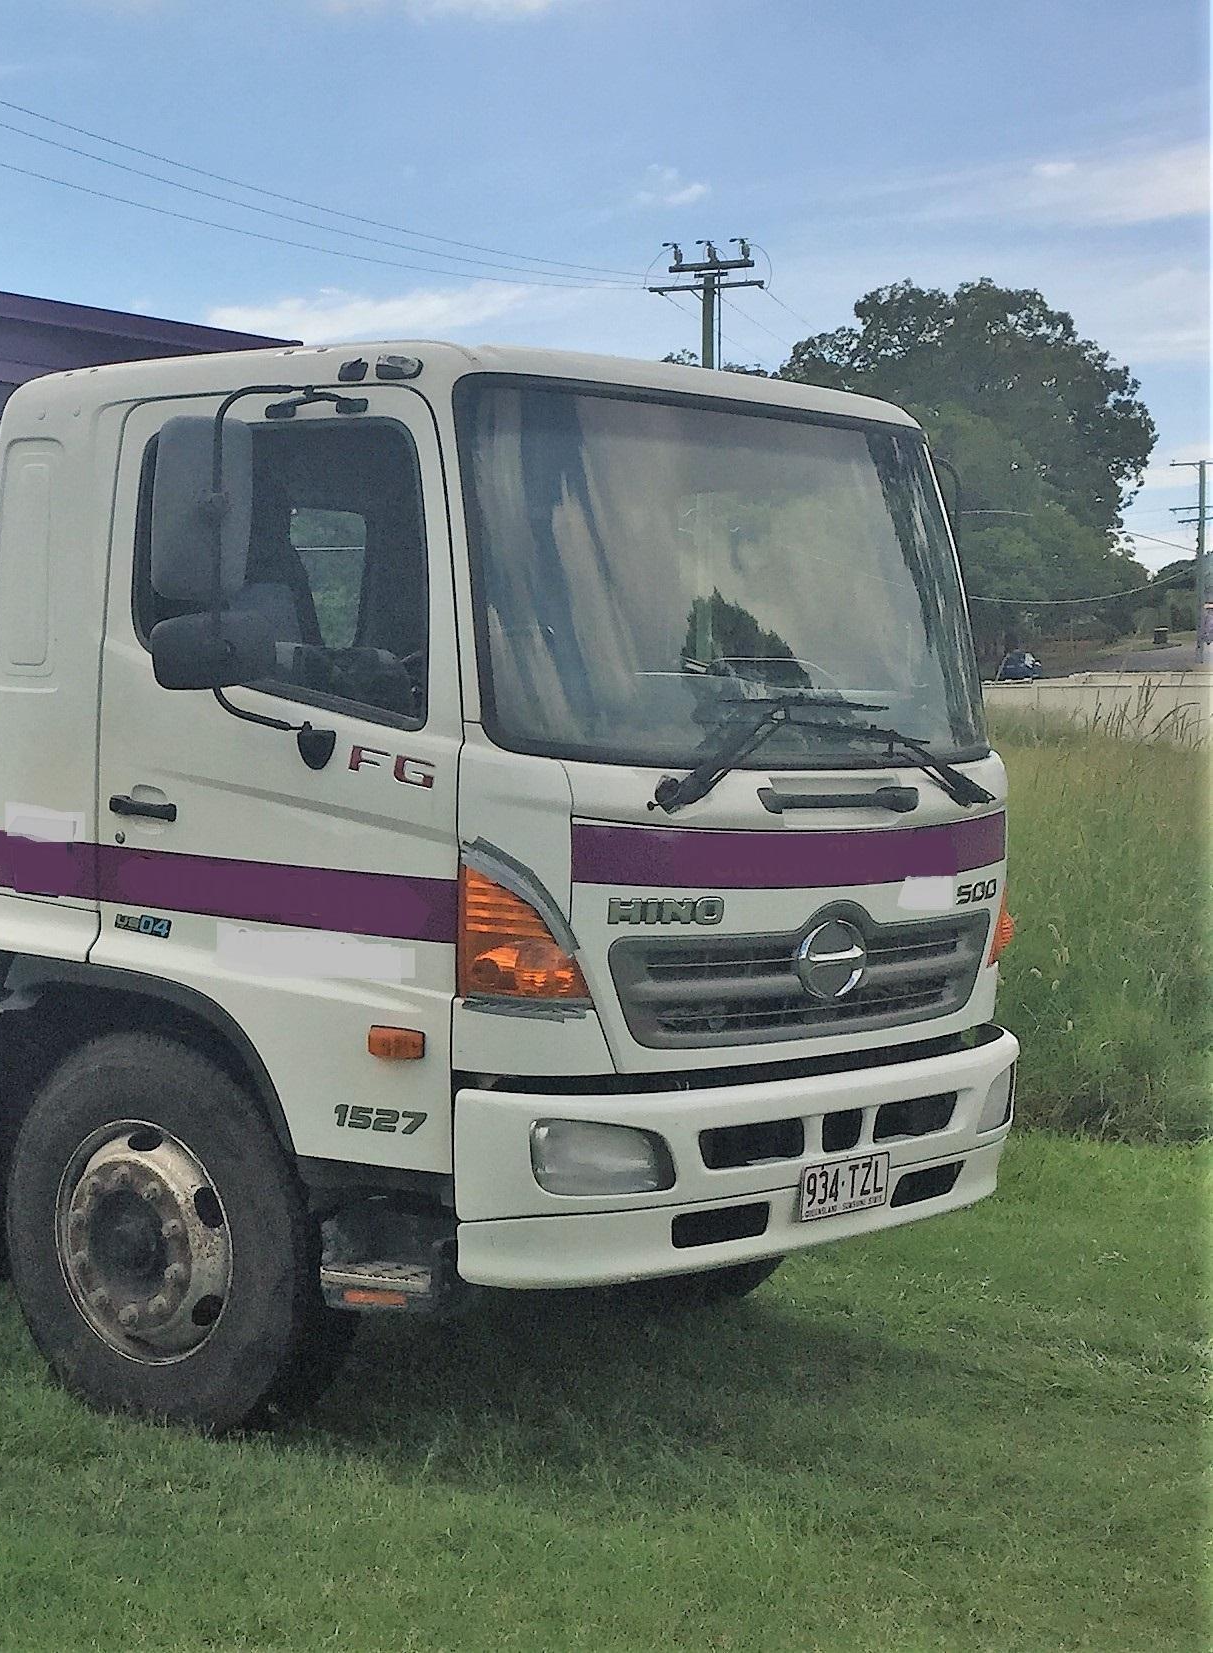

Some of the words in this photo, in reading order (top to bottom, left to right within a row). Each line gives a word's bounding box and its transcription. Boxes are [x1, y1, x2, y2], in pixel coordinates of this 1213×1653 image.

[348, 745, 435, 790] FG
[956, 879, 997, 905] 500
[607, 896, 724, 925] HINO
[334, 1104, 427, 1134] 1527
